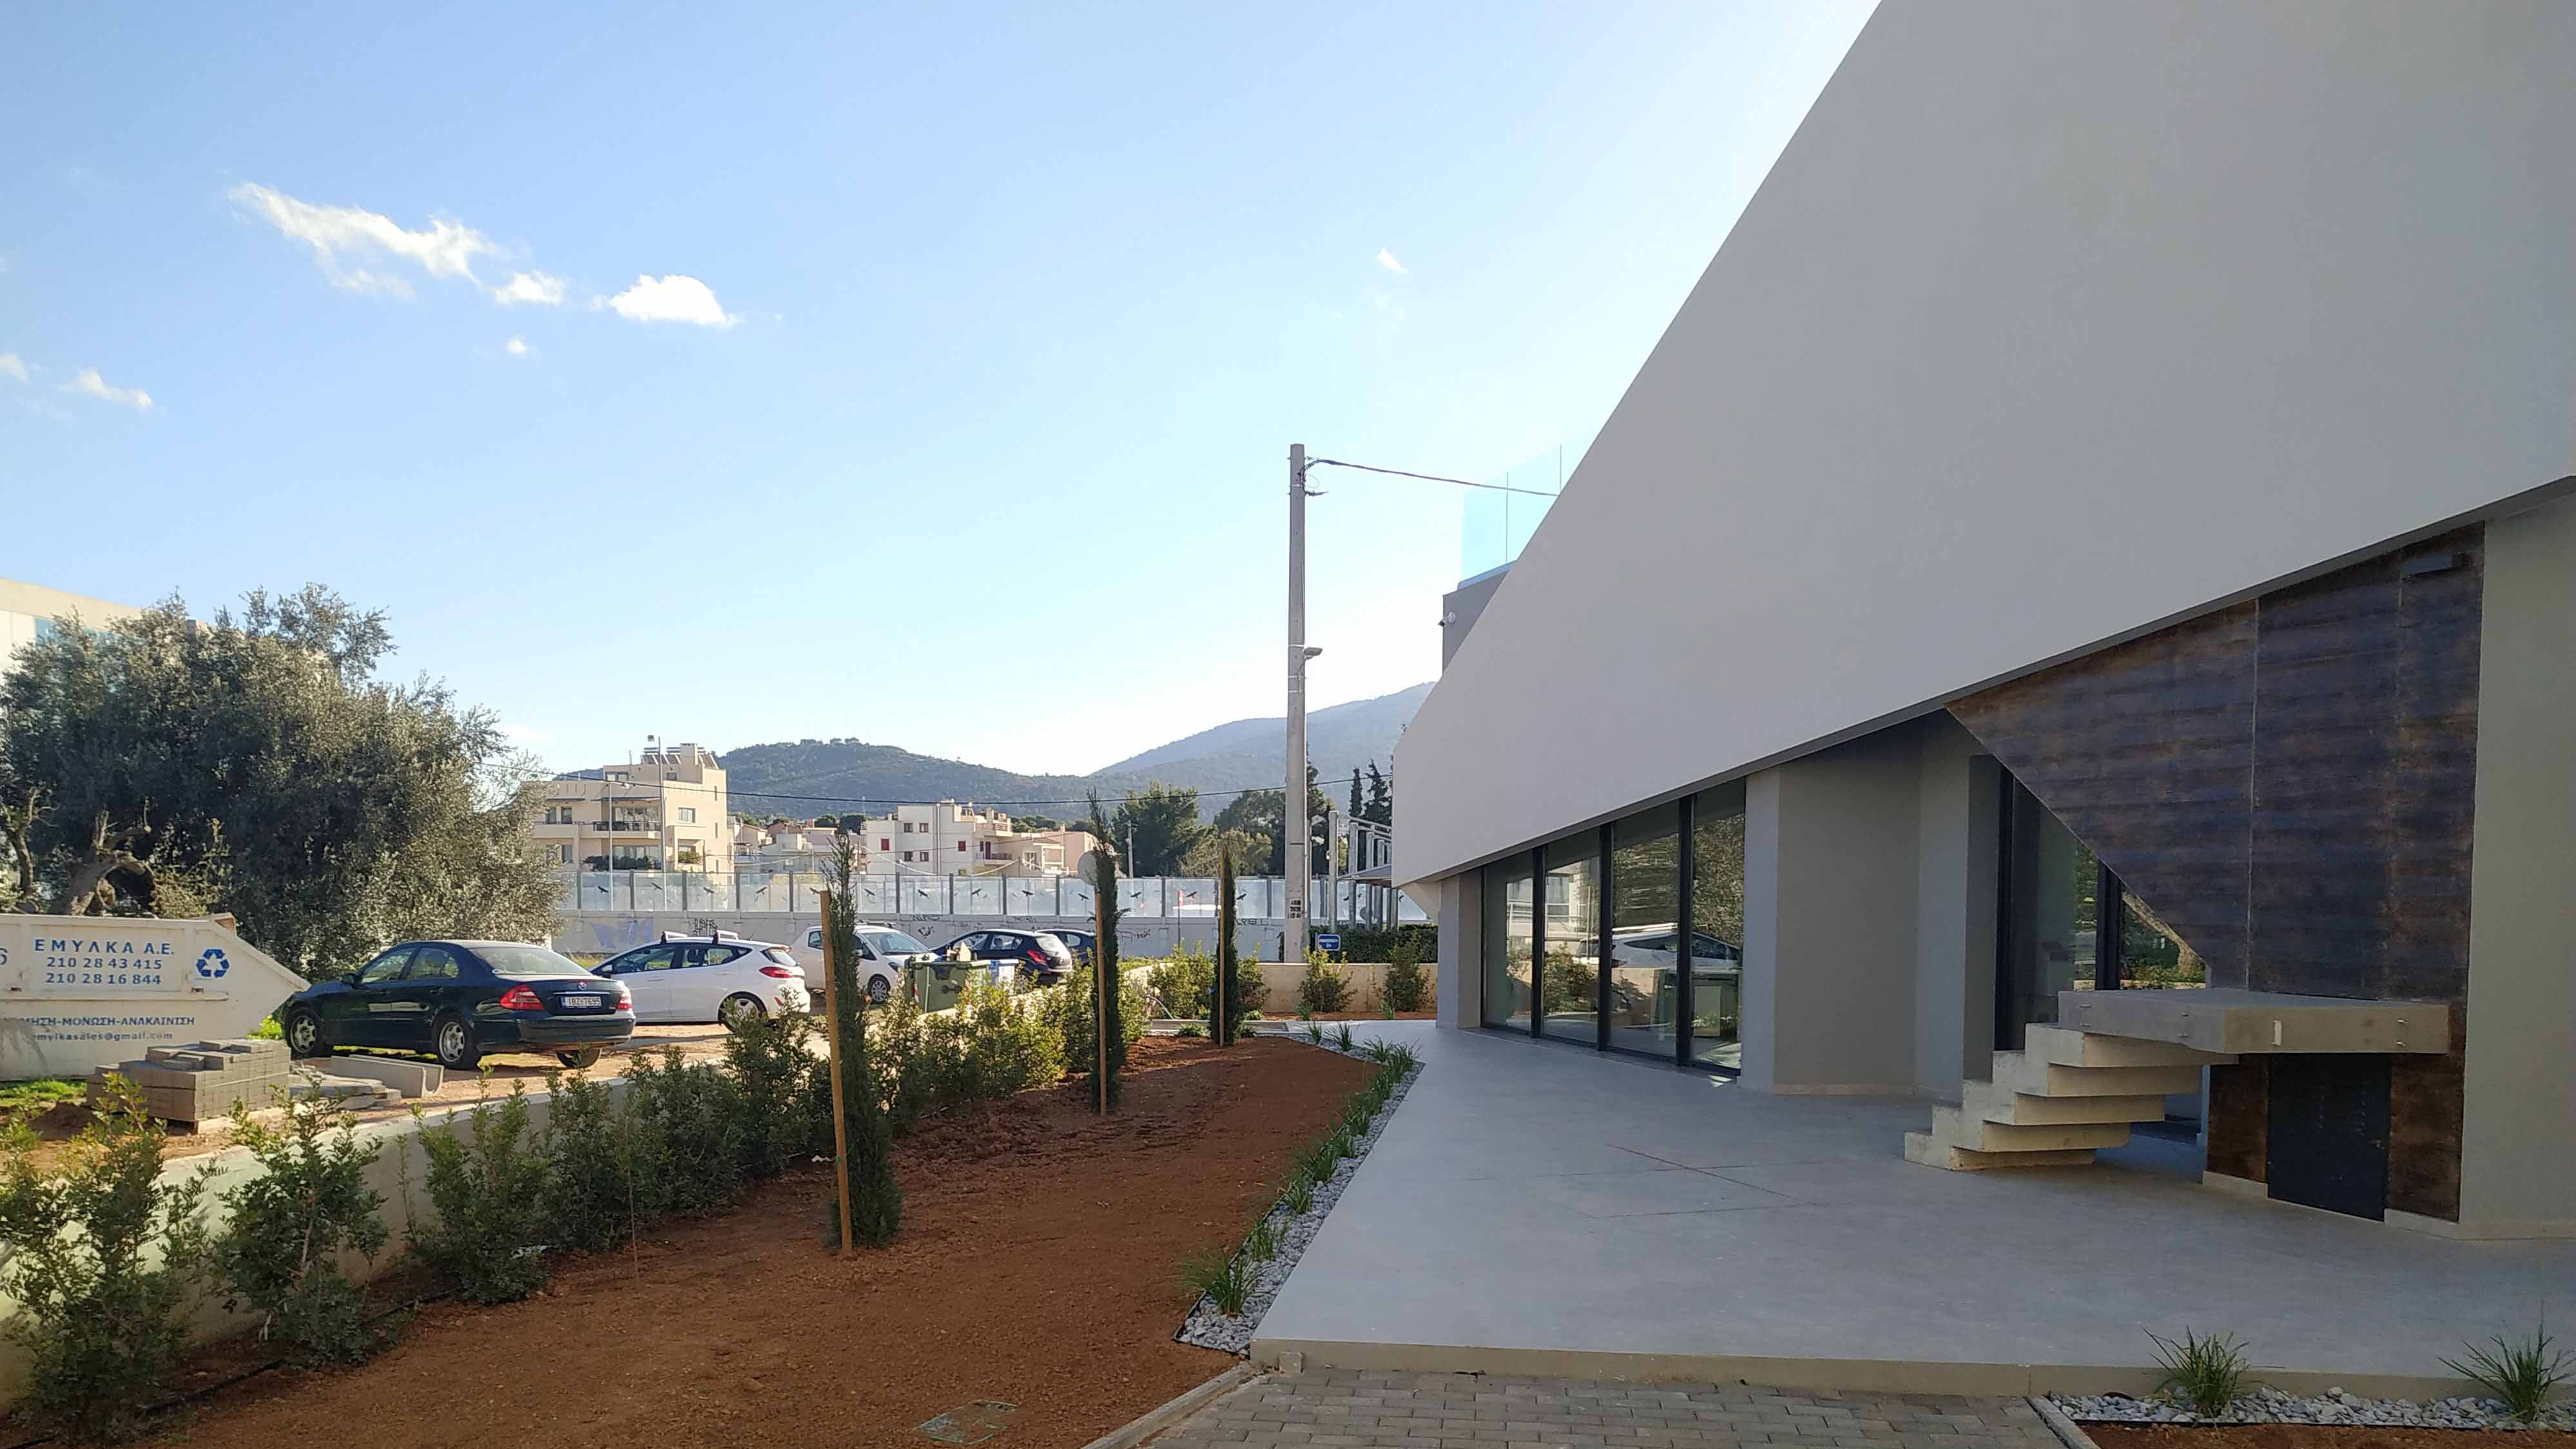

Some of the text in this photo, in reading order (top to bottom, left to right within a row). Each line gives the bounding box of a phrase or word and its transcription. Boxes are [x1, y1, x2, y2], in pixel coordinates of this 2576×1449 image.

[46, 957, 162, 969] 210 28 43 415
[46, 973, 161, 985] 210 28 16 844
